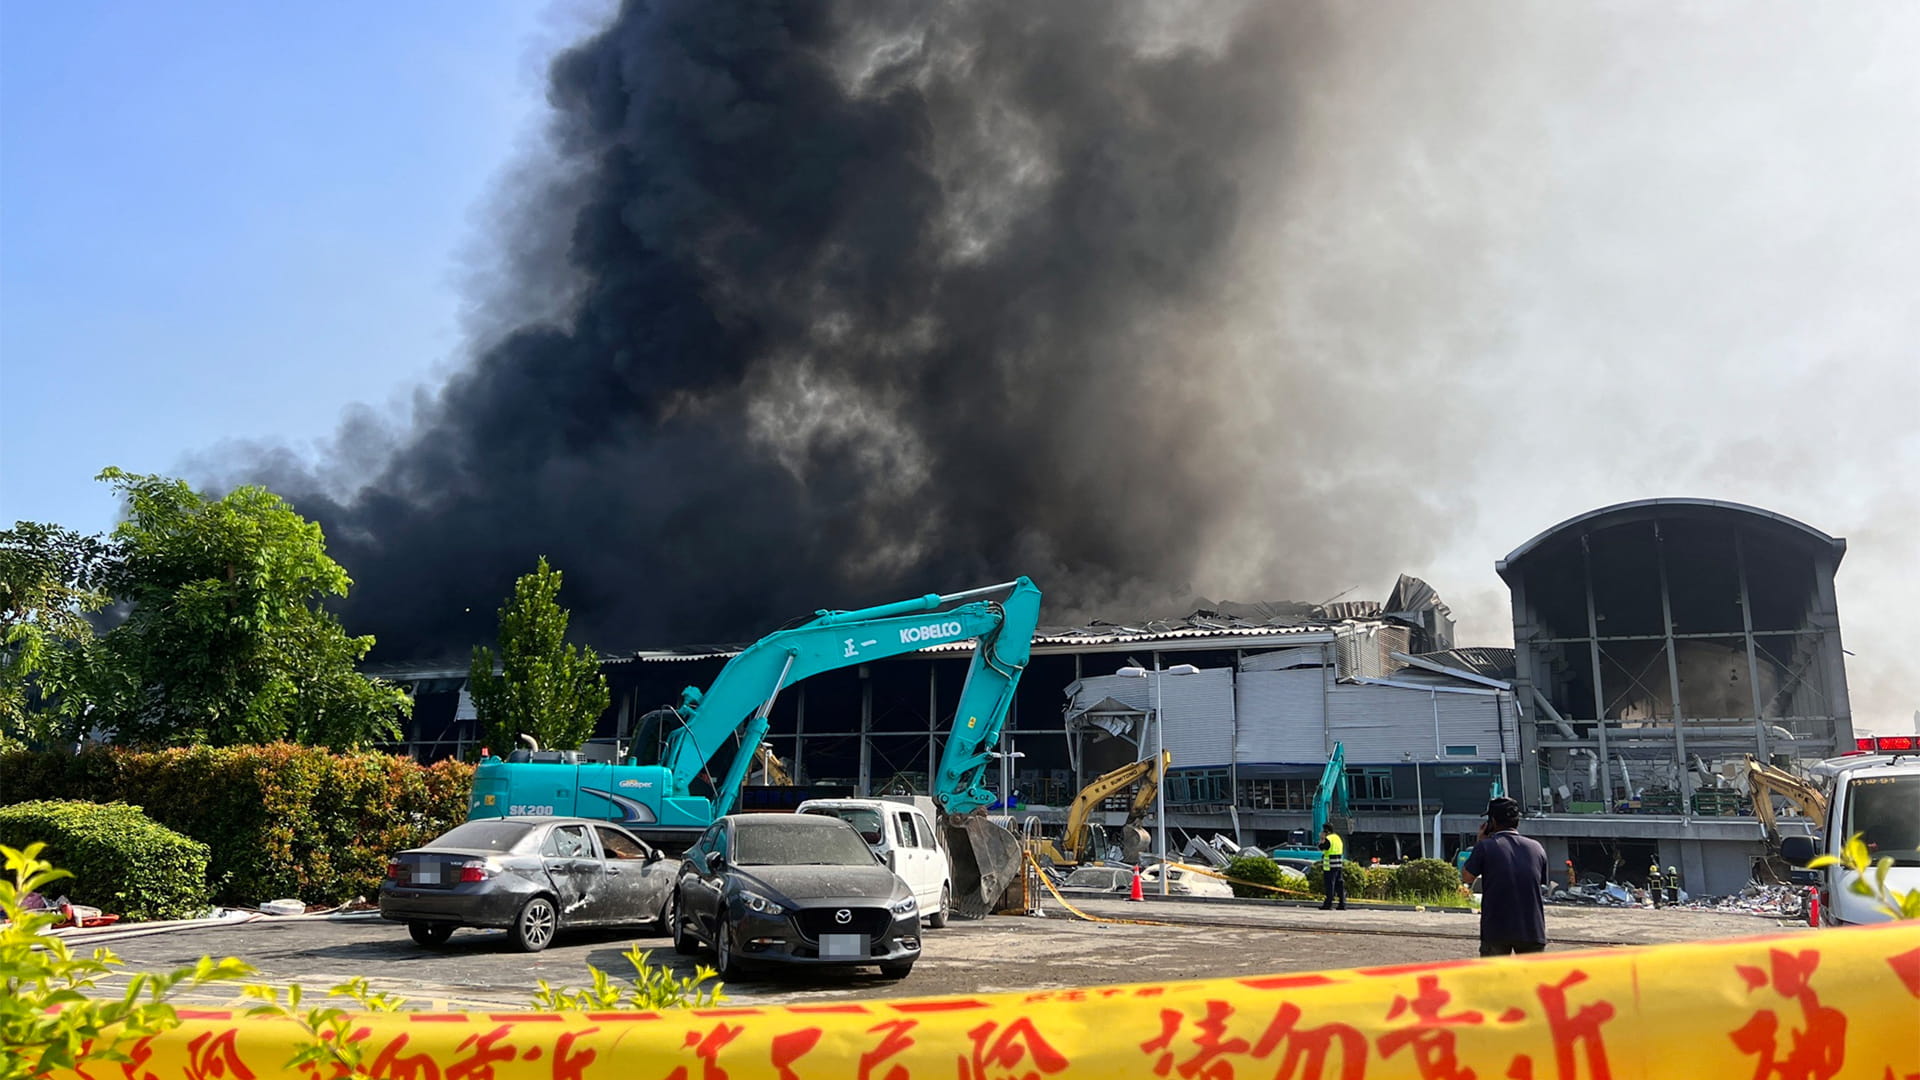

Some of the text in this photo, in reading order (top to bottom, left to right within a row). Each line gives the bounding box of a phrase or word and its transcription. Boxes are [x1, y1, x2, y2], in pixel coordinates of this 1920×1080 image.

[899, 621, 962, 643] KOBELCO
[844, 638, 877, 658] 正一
[509, 805, 554, 816] SK200
